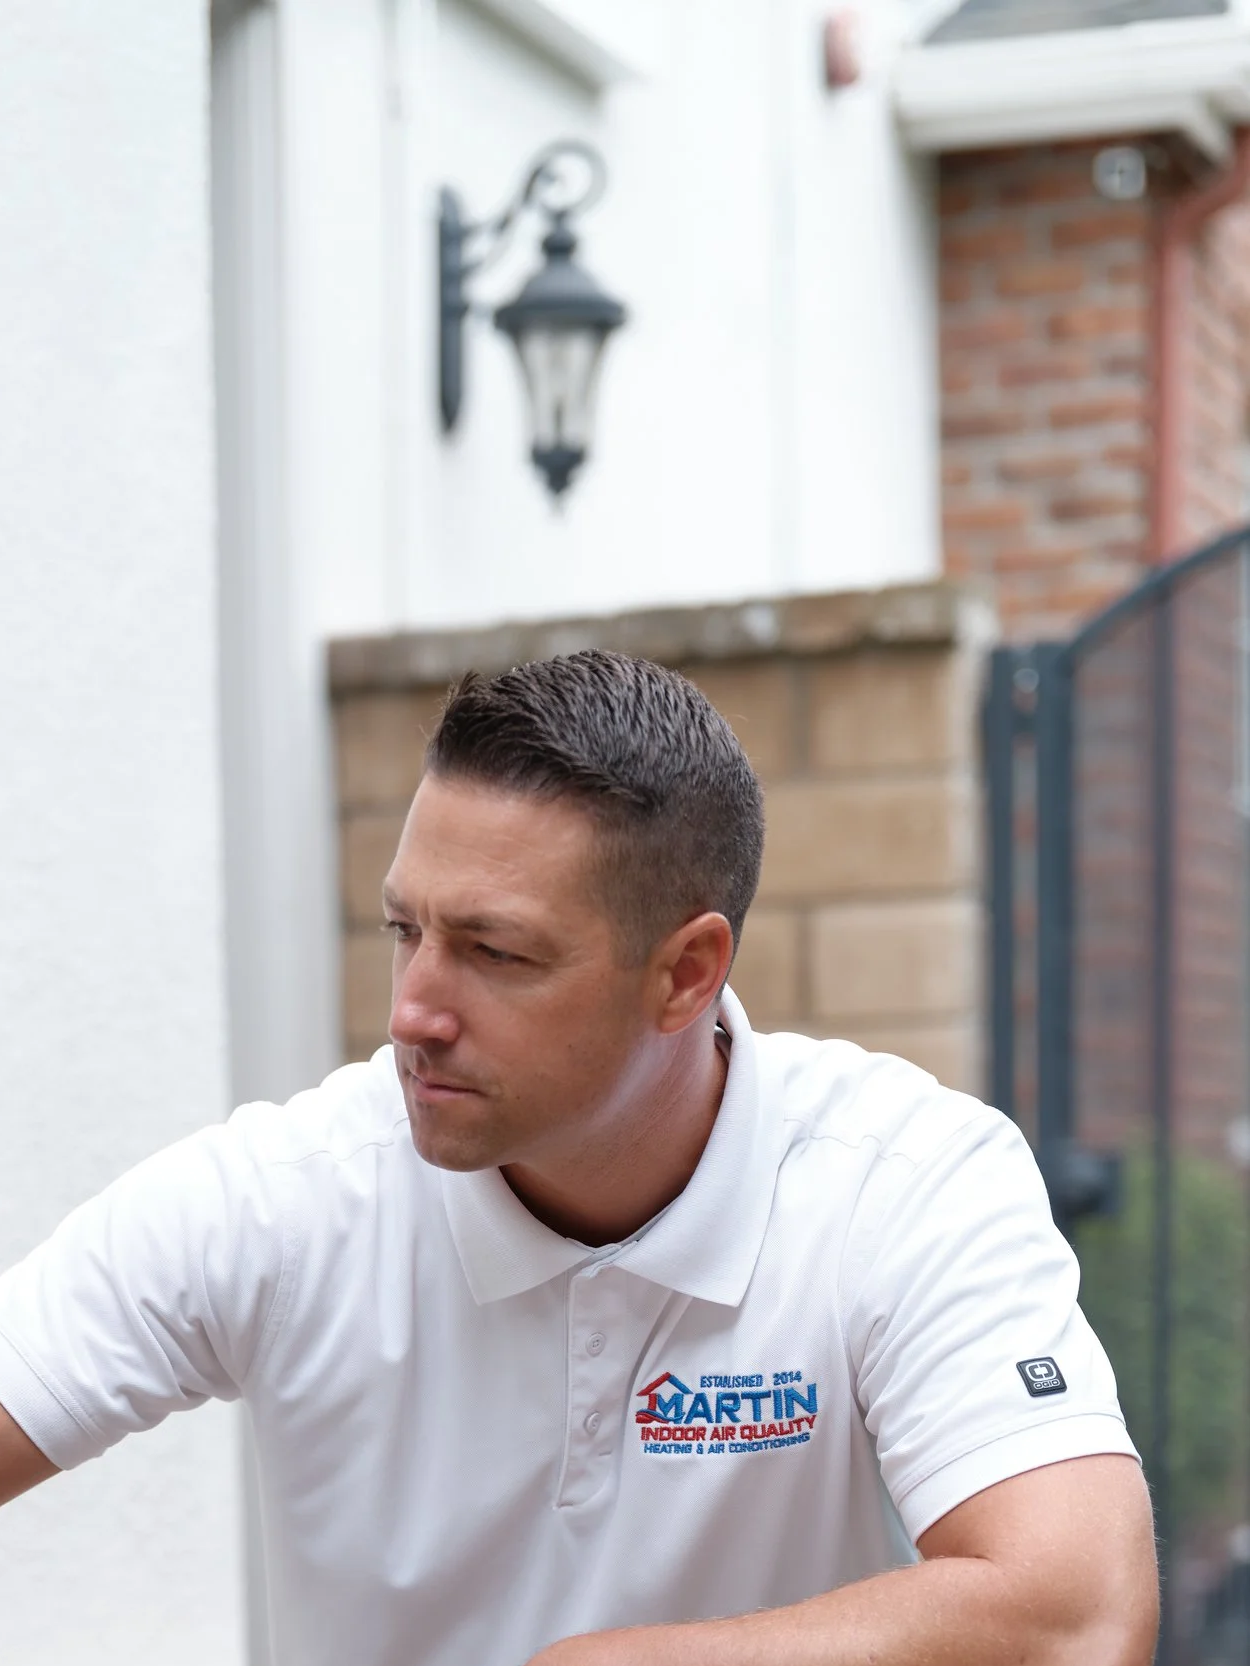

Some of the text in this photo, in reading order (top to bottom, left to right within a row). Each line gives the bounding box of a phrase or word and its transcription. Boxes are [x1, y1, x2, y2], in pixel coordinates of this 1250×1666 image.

[700, 1371, 802, 1388] ESTABLISHED 2014
[647, 1383, 818, 1424] MARTIN
[641, 1415, 817, 1441] INDOOR AIR QUALITY
[644, 1432, 811, 1454] HEATING & AIR CONDITIONING
